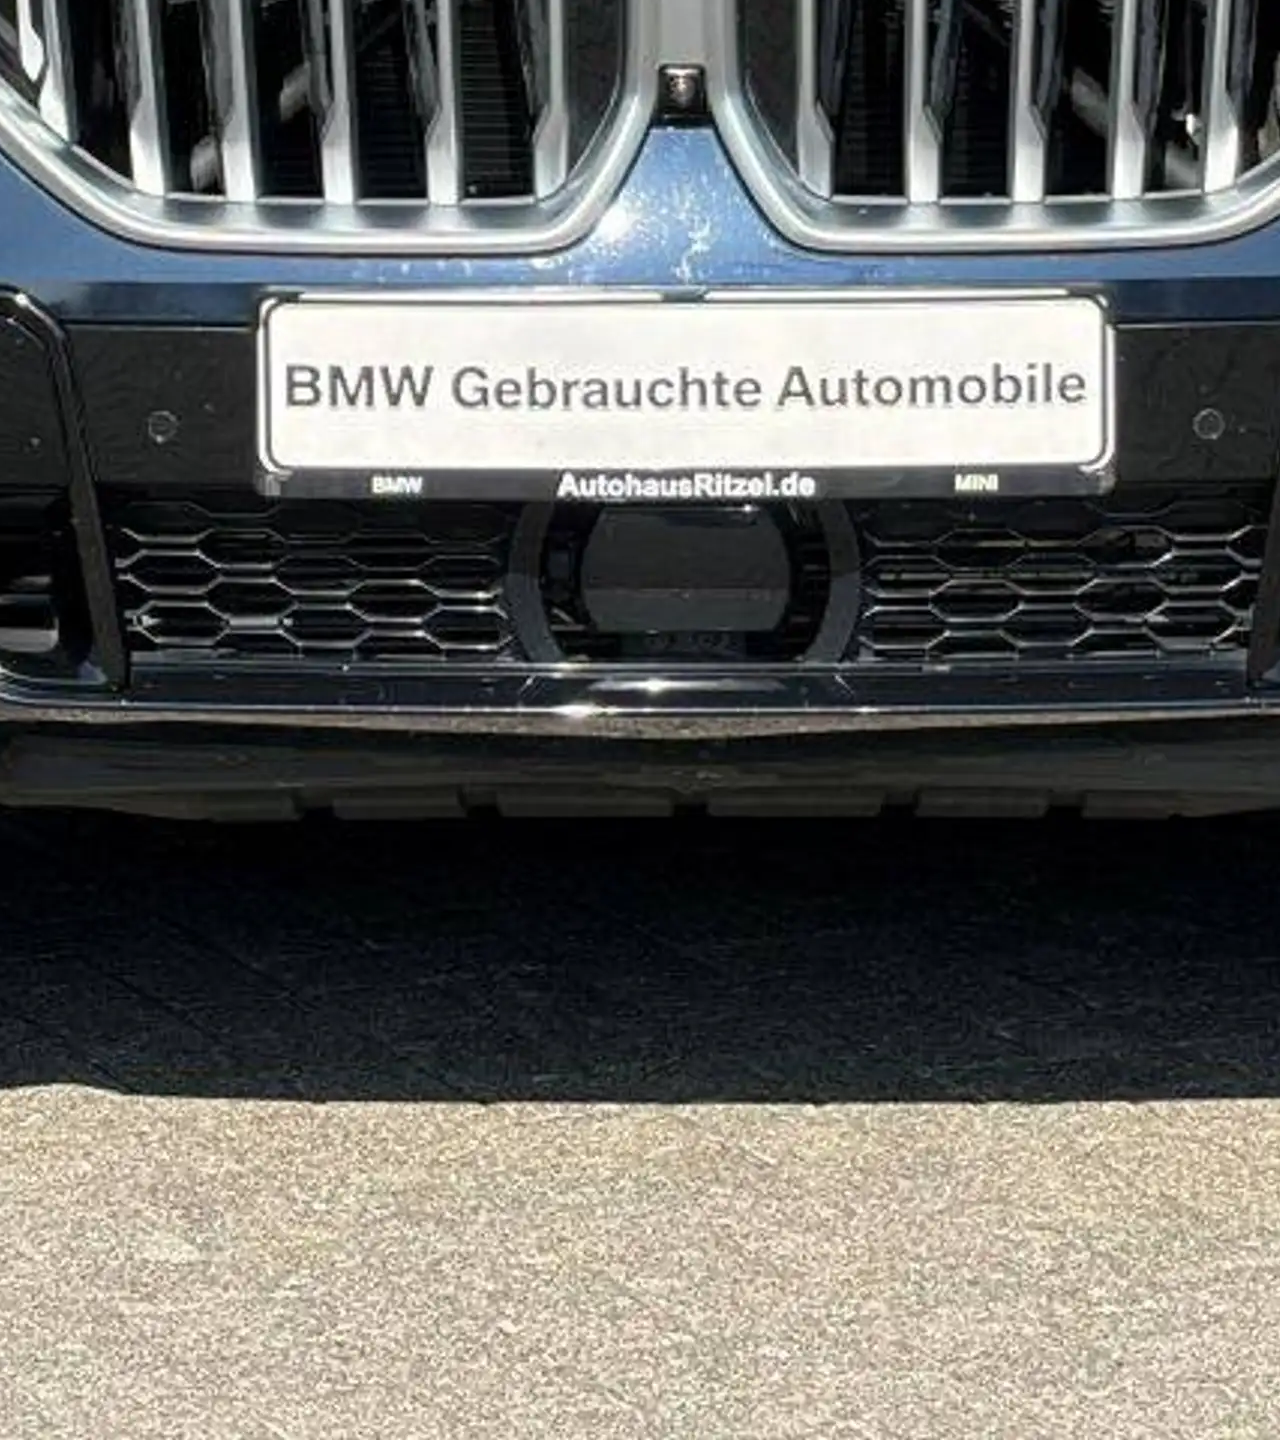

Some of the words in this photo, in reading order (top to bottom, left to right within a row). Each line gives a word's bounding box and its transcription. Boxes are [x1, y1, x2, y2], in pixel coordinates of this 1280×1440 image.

[285, 364, 434, 407] BMW
[451, 365, 762, 409] Gebrauchte
[777, 362, 1087, 407] Automobile
[371, 476, 423, 494] BMW
[556, 471, 817, 498] AutohausRitzel.de
[954, 473, 999, 492] MINI
